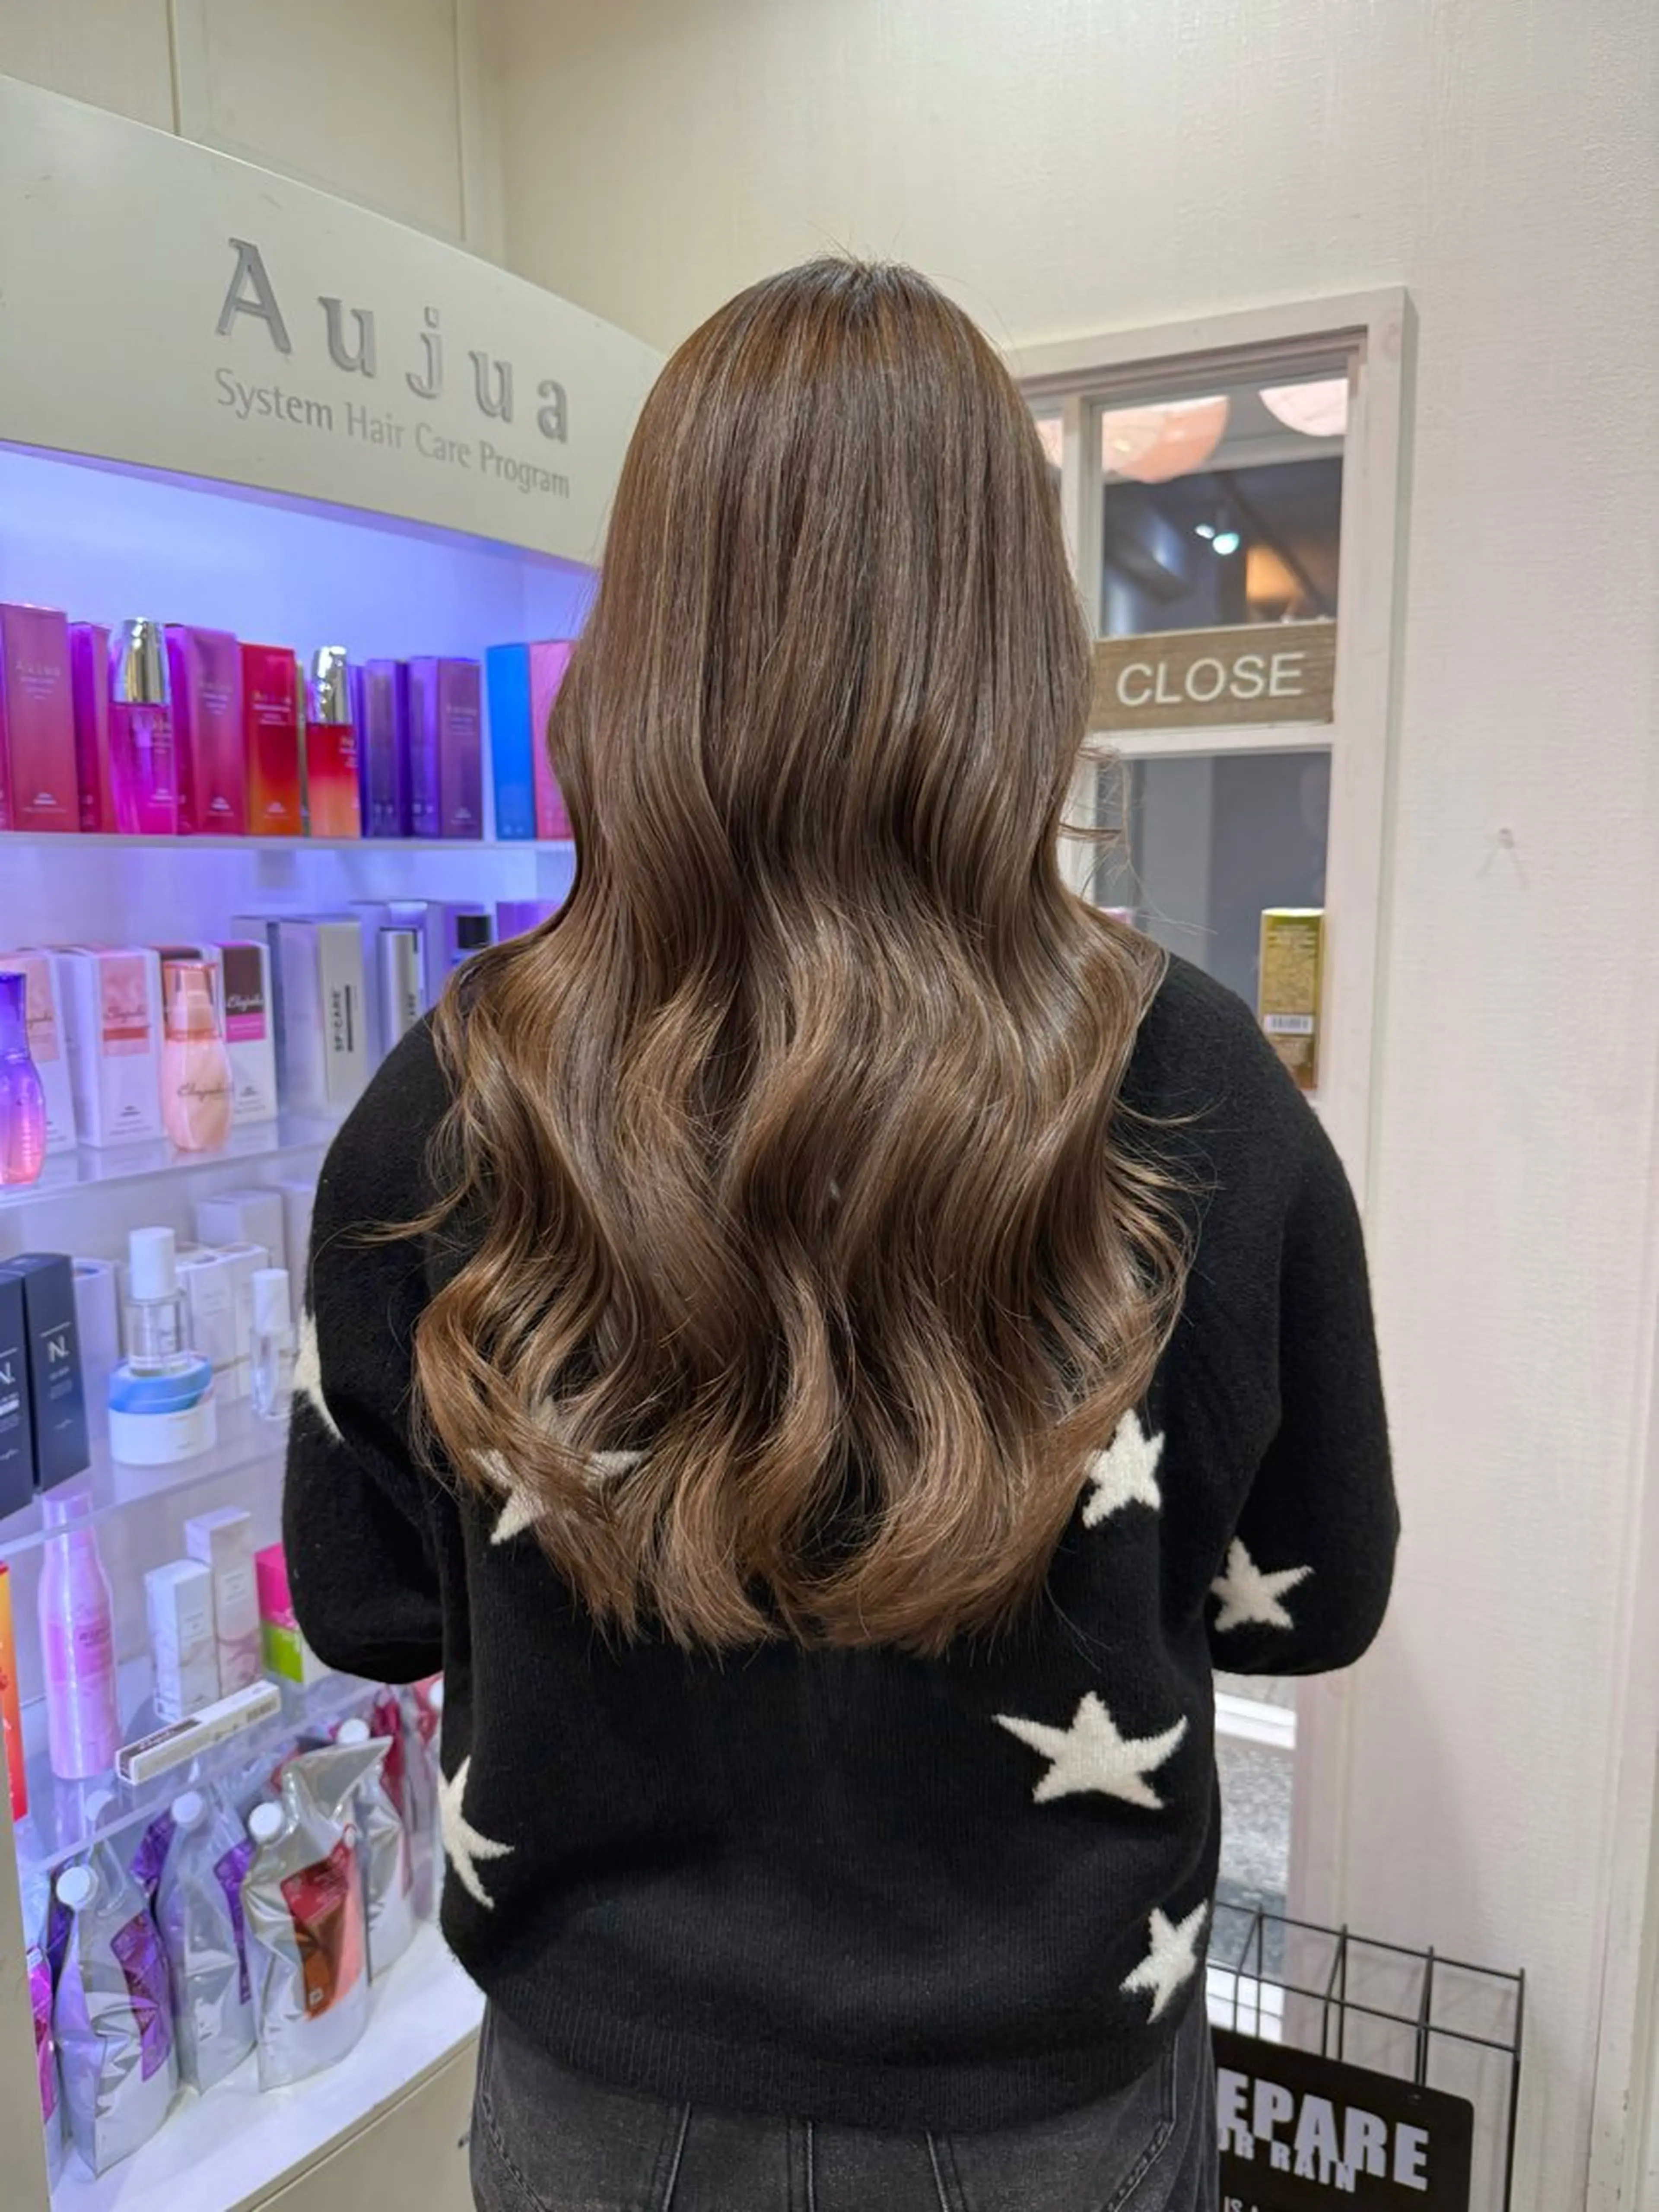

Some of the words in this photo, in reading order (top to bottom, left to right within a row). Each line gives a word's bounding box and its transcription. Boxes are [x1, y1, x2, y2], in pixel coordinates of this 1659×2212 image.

[215, 237, 569, 444] Aujua
[215, 368, 333, 431] System
[346, 402, 405, 449] Hair
[415, 422, 471, 469] Care
[479, 440, 570, 499] Program
[1116, 652, 1305, 706] CLOSE
[1216, 2066, 1429, 2192] EPARE
[1269, 2139, 1356, 2193] RAIN
